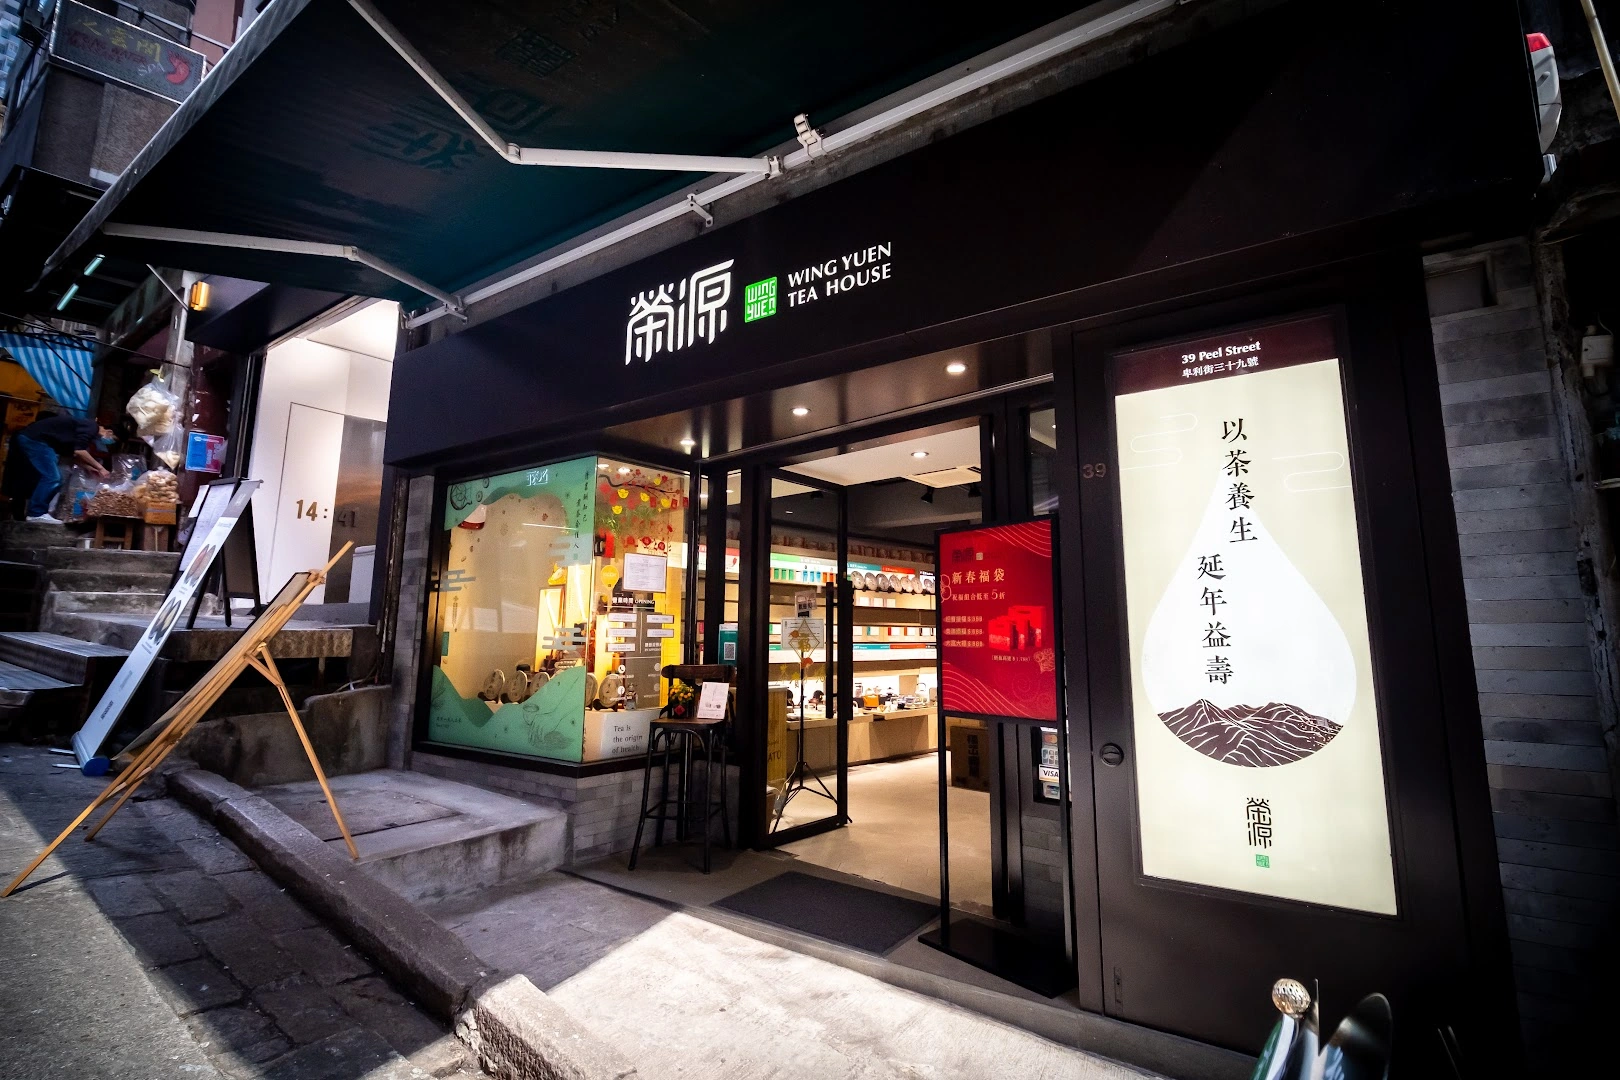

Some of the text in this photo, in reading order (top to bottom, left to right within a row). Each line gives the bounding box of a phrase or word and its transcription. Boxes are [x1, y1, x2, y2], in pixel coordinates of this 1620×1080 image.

[137, 62, 165, 76] SPA
[787, 241, 892, 288] WING YUEN
[787, 262, 892, 308] TEA HOUSE
[625, 258, 735, 366] 榮源
[1181, 341, 1261, 364] 39 Peel Street
[1082, 462, 1107, 479] 39
[1221, 418, 1258, 543] 以茶養生
[952, 567, 1005, 585] 新春福袋
[1197, 553, 1234, 685] 延年益壽
[624, 734, 643, 742] origin
[612, 746, 620, 754] of
[1042, 768, 1059, 778] VISA
